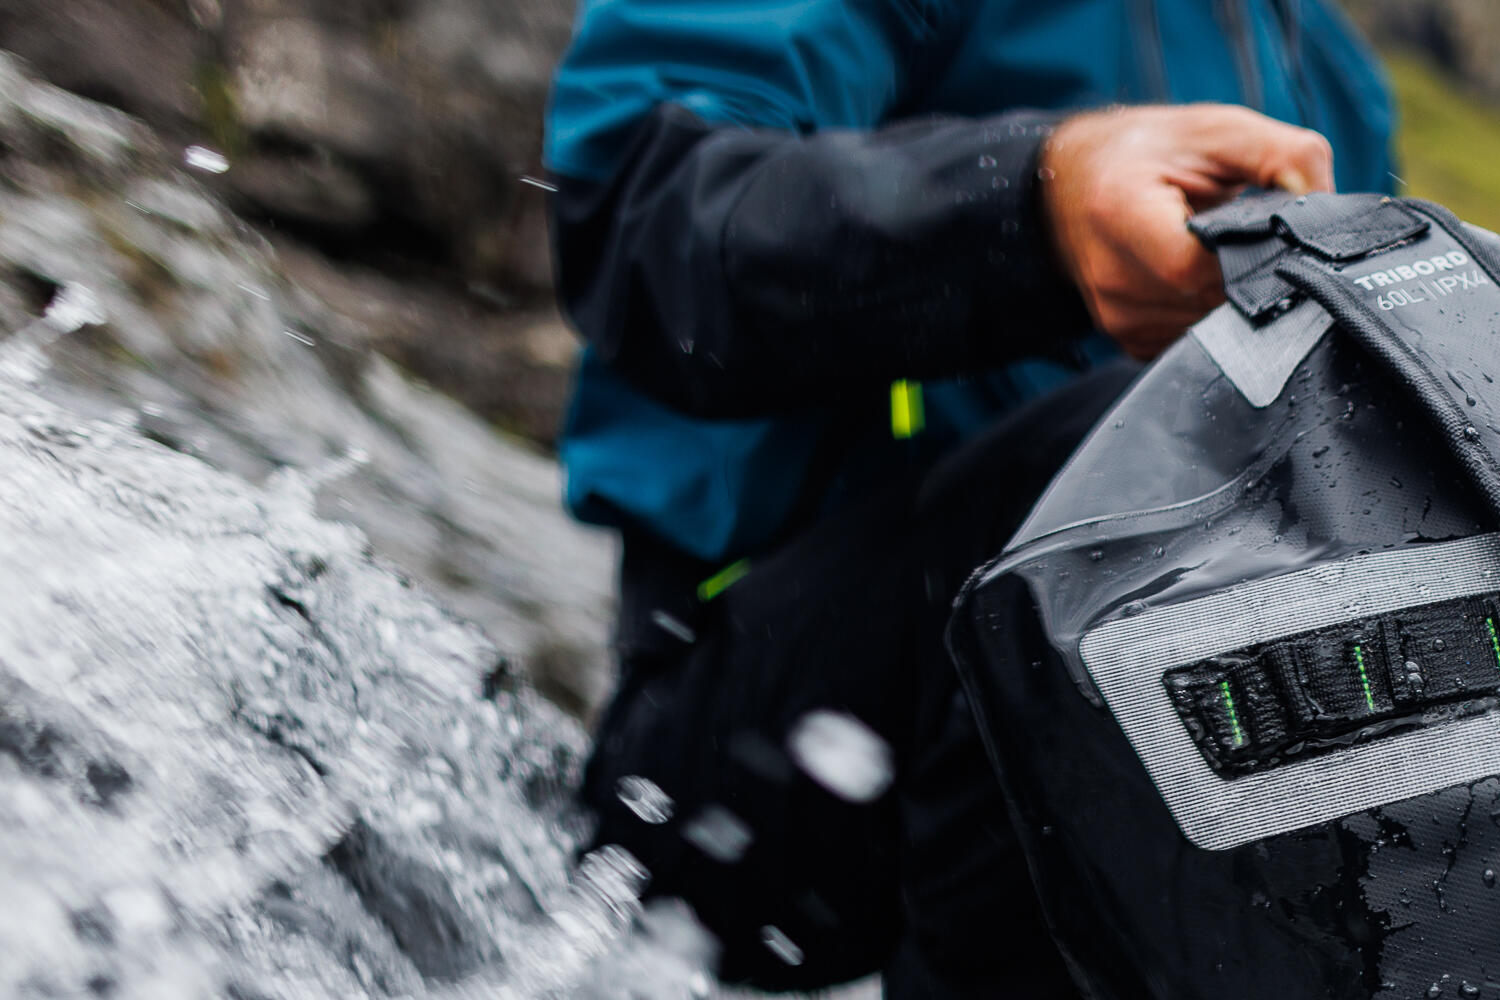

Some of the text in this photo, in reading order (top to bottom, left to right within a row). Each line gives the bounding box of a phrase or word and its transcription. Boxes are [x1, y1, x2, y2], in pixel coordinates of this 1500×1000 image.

[1353, 251, 1468, 291] TRIBORD
[1377, 288, 1424, 311] 60L
[1430, 269, 1488, 296] IPX4
